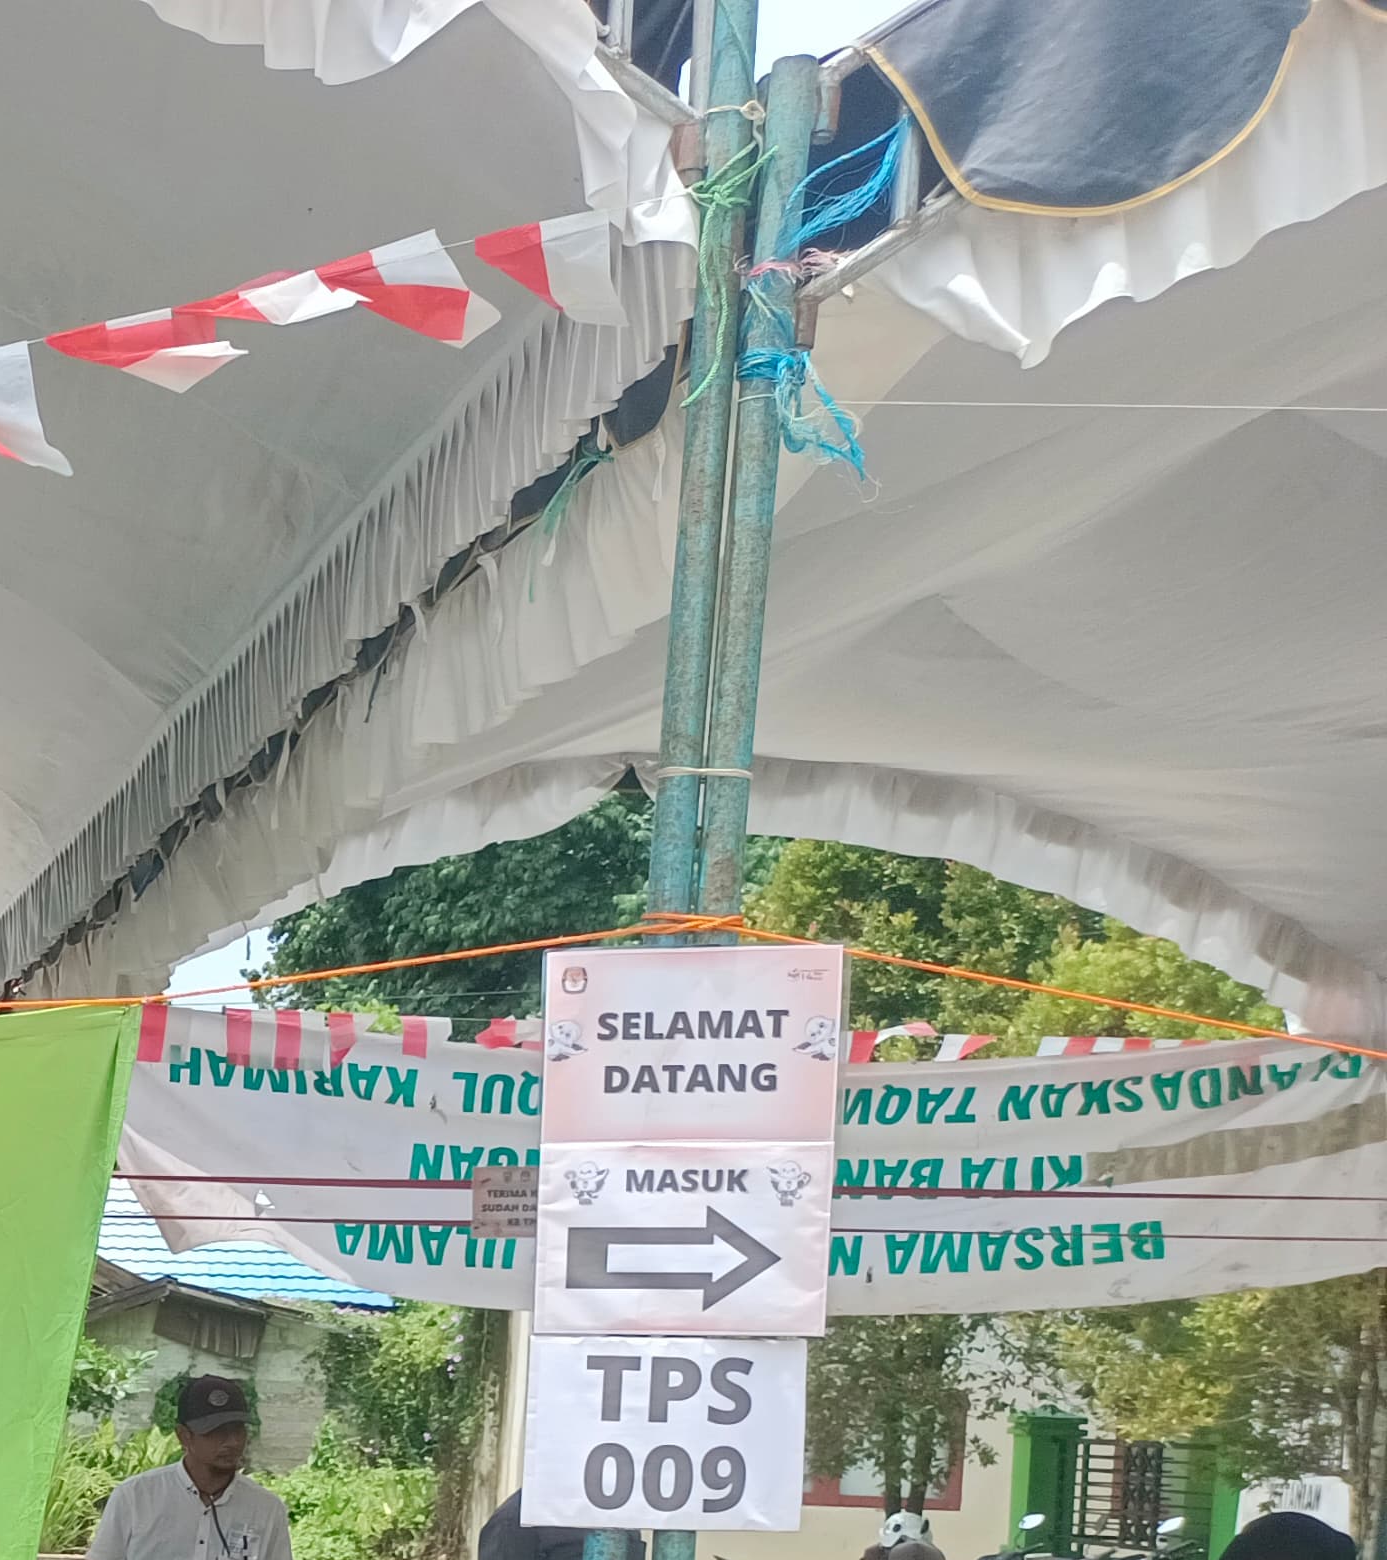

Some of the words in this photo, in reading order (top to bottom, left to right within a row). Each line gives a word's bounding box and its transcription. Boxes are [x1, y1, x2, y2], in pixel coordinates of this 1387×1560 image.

[596, 1008, 790, 1041] SELAMAT
[169, 1044, 418, 1108] KARIMAH
[603, 1062, 778, 1094] DATANG
[625, 1168, 749, 1194] MASUK
[481, 1203, 519, 1213] SUDAH
[885, 1220, 1166, 1275] BERSAMA
[586, 1355, 755, 1426] TPS
[583, 1442, 747, 1514] 009
